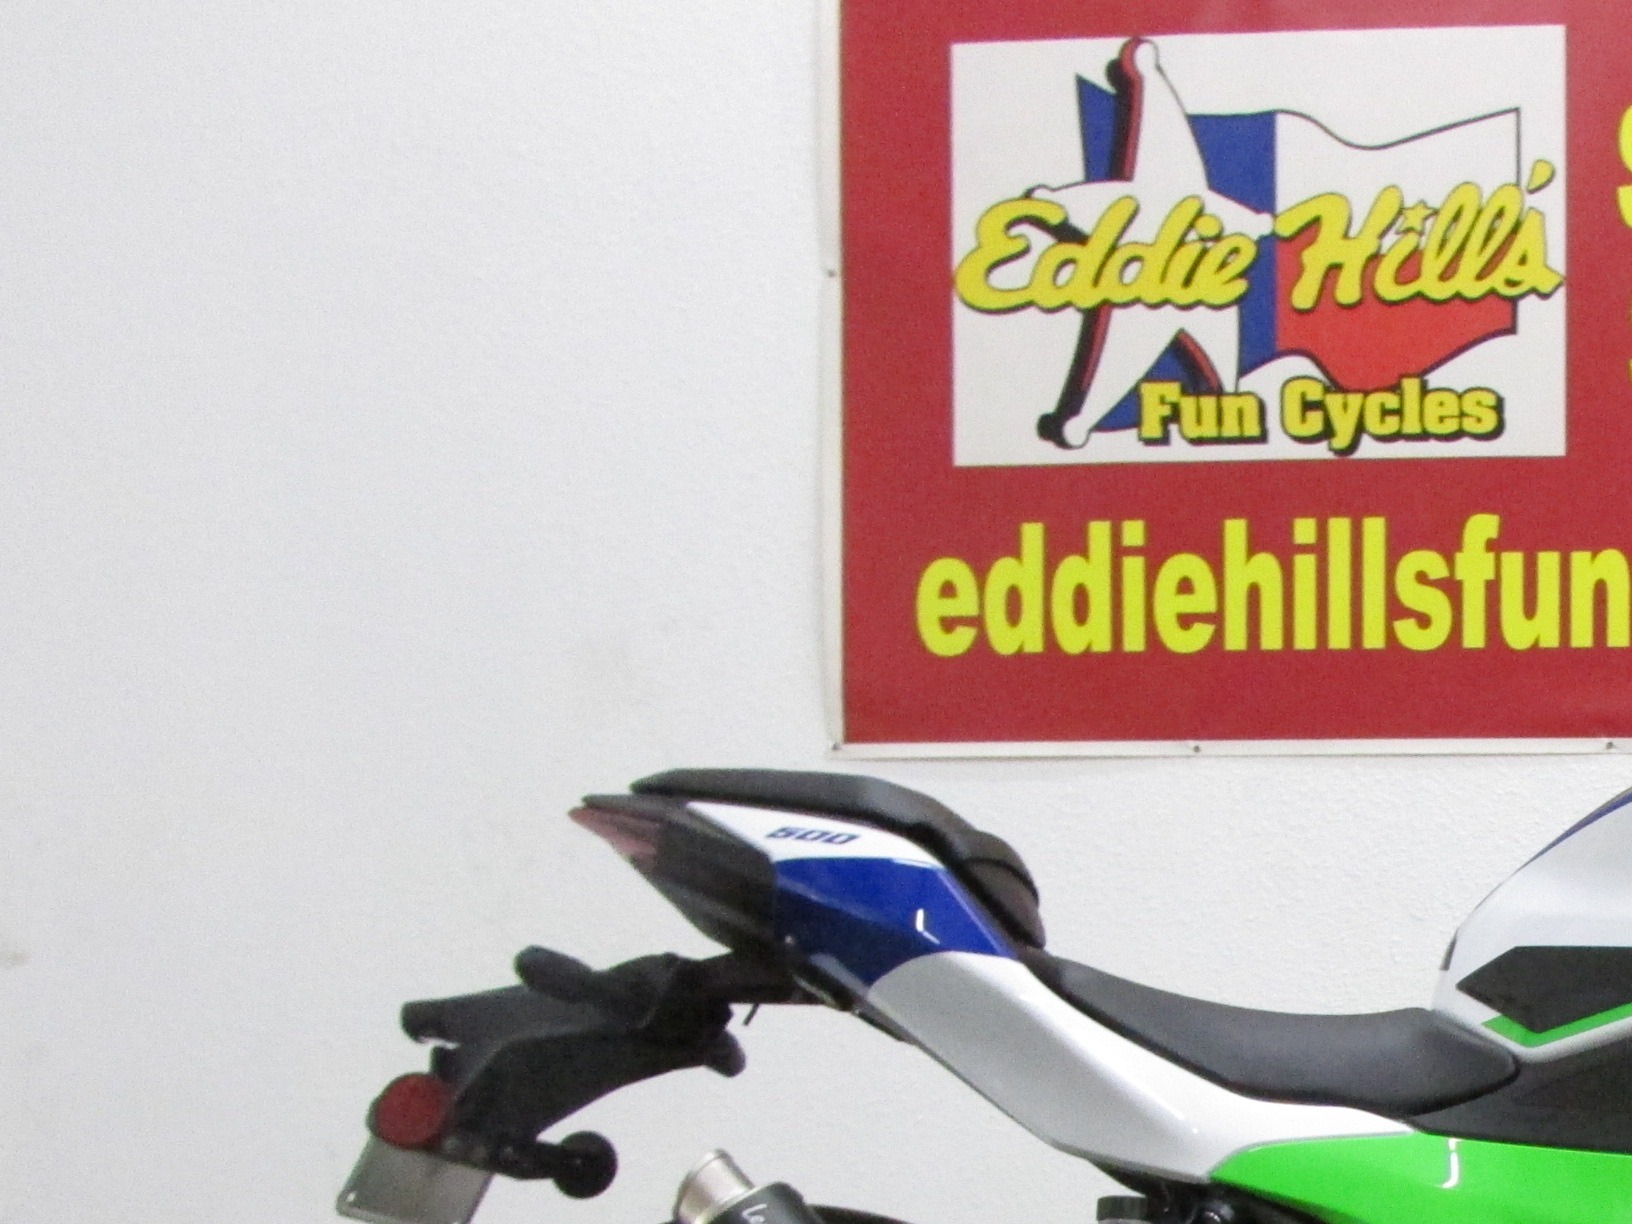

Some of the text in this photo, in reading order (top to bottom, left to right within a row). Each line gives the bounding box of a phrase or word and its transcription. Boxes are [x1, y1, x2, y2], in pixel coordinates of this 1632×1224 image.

[953, 158, 1565, 314] Eddie Hill's
[1137, 376, 1503, 455] Fun Cycles
[766, 827, 861, 845] 500
